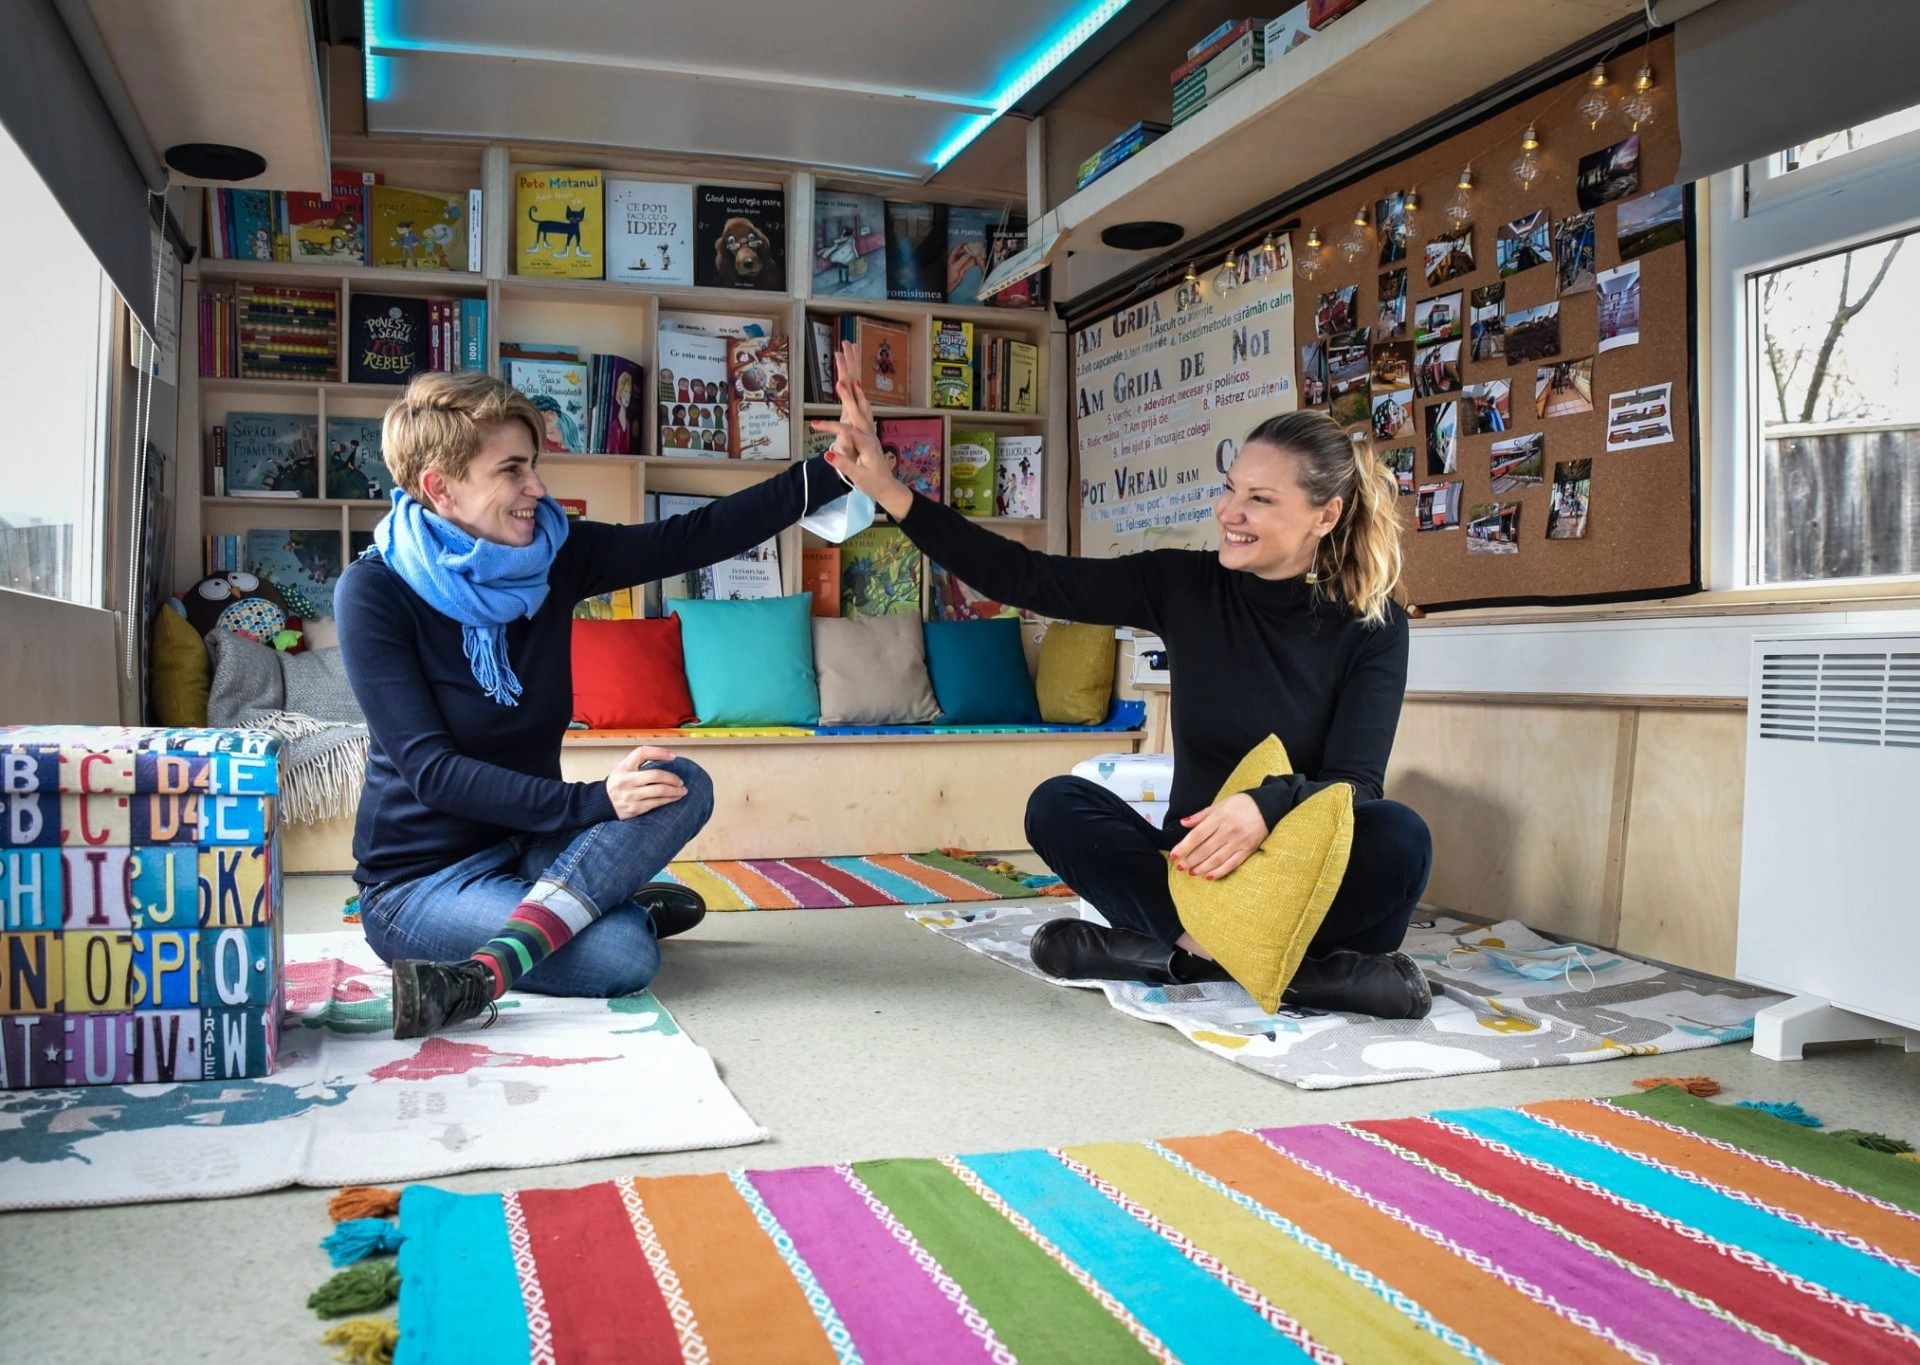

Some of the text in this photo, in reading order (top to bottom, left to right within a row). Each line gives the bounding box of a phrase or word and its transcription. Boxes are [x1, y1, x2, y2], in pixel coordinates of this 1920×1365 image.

[520, 176, 598, 189] Pete Motanul
[626, 220, 677, 236] IDEE?
[887, 288, 942, 299] romisiunea
[1270, 293, 1292, 309] calm
[1077, 327, 1102, 357] AM
[1112, 301, 1161, 338] GRIJA
[363, 349, 417, 374] REBELE
[1077, 325, 1271, 420] AM GRIJA DE NOI
[1214, 370, 1250, 392] politicos
[1081, 479, 1106, 508] POT
[1114, 466, 1168, 499] VREAU
[1178, 507, 1213, 524] inteligent
[80, 753, 112, 794] C
[10, 852, 43, 926] H
[87, 851, 109, 925] I
[148, 853, 175, 923] J
[218, 850, 243, 925] K
[9, 935, 47, 1010] N
[214, 928, 249, 1006] Q
[15, 1016, 40, 1088] T
[84, 1018, 116, 1084] U
[222, 1013, 247, 1078] W
[204, 1008, 216, 1080] RAILE
